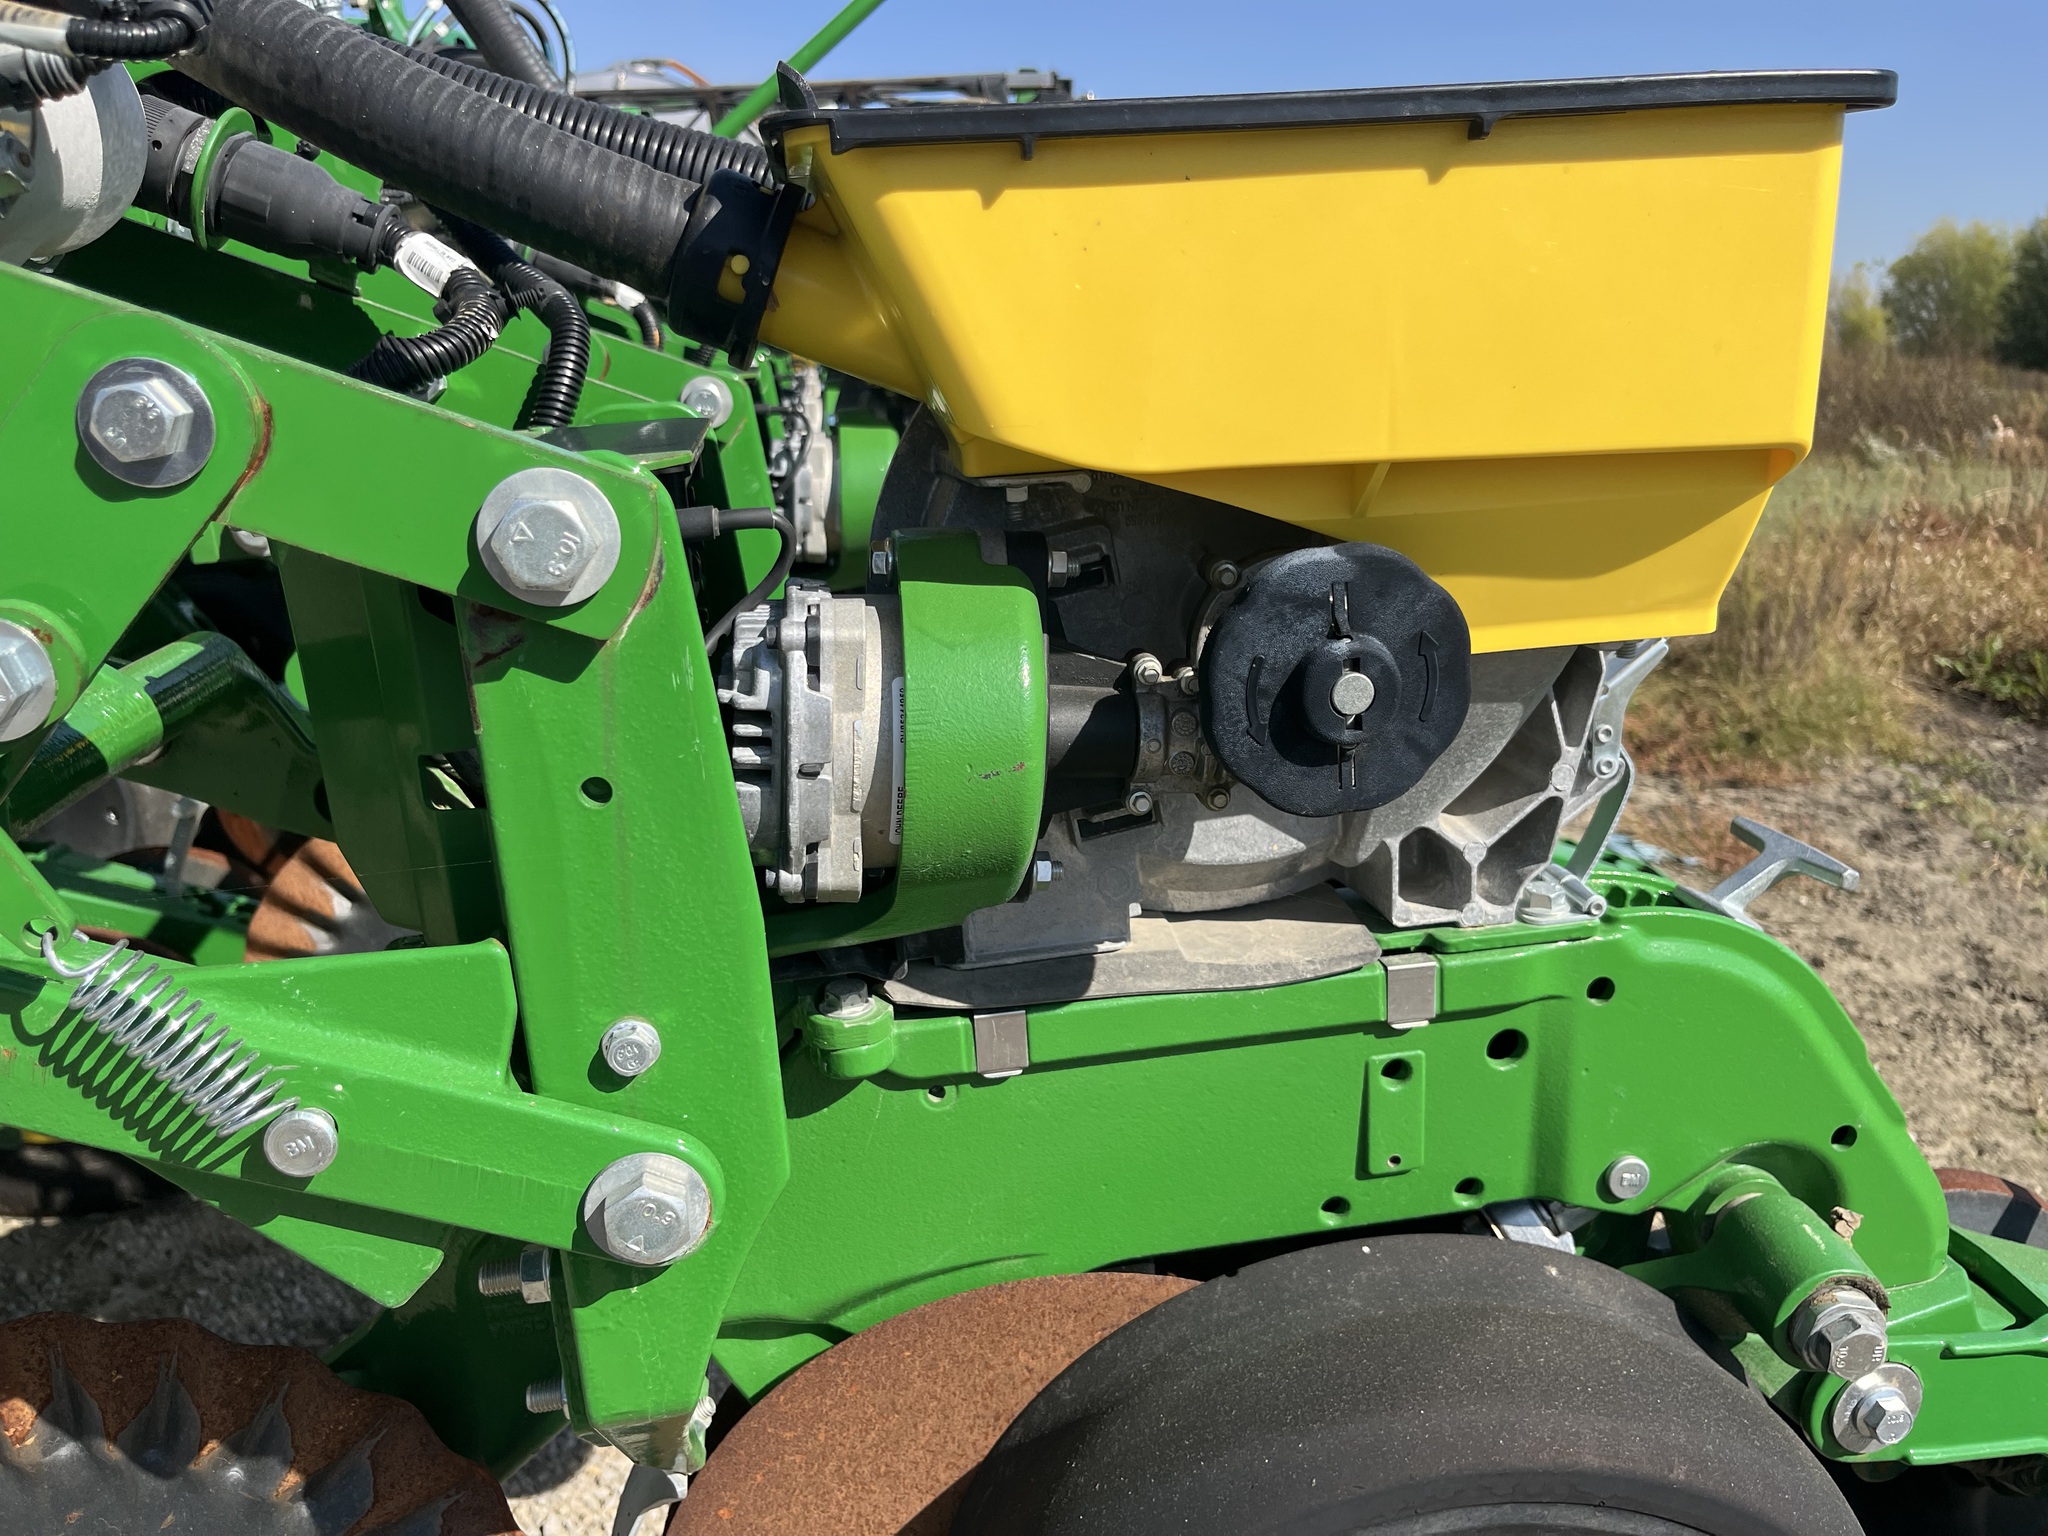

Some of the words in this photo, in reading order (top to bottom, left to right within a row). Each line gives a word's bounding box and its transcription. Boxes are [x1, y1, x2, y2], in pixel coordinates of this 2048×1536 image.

[547, 531, 582, 577] 10.9
[637, 1199, 677, 1226] 10.9
[1836, 1345, 1850, 1369] 10.9
